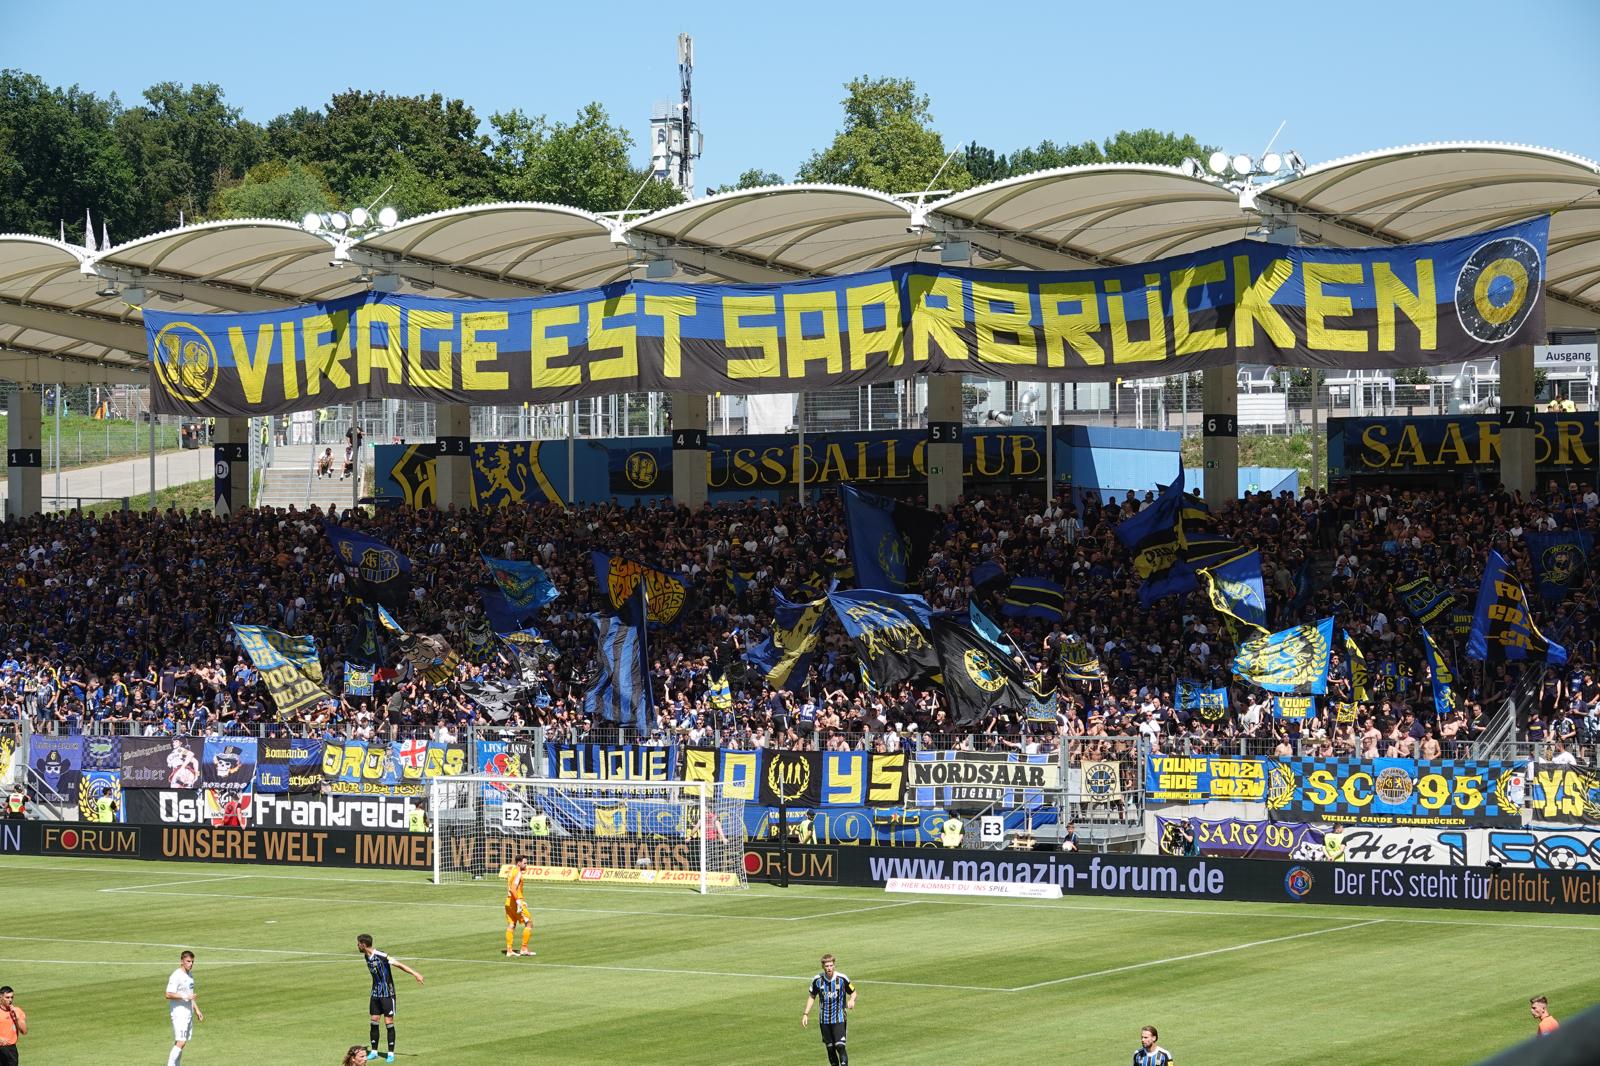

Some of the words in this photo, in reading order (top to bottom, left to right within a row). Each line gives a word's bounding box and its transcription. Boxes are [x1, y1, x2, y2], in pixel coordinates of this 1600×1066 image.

[228, 303, 509, 403] VIRAGE
[531, 293, 697, 388] EST
[722, 254, 1438, 379] SAARBRÜCKEN
[1545, 350, 1591, 363] Ausgang
[1506, 411, 1515, 424] 7
[1208, 419, 1216, 432] 6
[932, 427, 940, 439] 5
[439, 440, 447, 452] 3
[677, 436, 685, 446] 4
[11, 452, 17, 463] 1
[236, 446, 242, 458] 2
[1278, 697, 1312, 708] YOUNG
[802, 704, 815, 717] 12
[1282, 707, 1306, 717] SIDE
[558, 750, 667, 781] CLIQUE
[1151, 757, 1207, 773] YOUNG
[914, 762, 1046, 787] NORDSAAR
[332, 781, 360, 793] NUR
[363, 783, 390, 794] DER
[1159, 774, 1198, 790] SIDE
[1305, 770, 1374, 806] SC
[1416, 773, 1484, 810] 95
[1539, 769, 1584, 817] YS
[159, 791, 205, 823] Ost
[504, 808, 520, 821] E2
[1321, 814, 1357, 823] VIEILLE
[1360, 815, 1393, 824] GARDE
[1396, 816, 1466, 825] SAARBRÜCKEN
[771, 825, 802, 836] BYS
[983, 822, 1001, 836] E3
[1198, 822, 1259, 845] SARG
[1265, 825, 1294, 849] 99
[4, 824, 21, 851] N
[45, 828, 136, 852] FORUM
[162, 828, 257, 859] UNSERE
[263, 831, 328, 863] WELT
[1342, 831, 1435, 864] Heja
[603, 870, 614, 878] IST
[673, 873, 700, 882] LOTTO
[869, 856, 1224, 894] www.magazin-forum.de
[901, 881, 919, 889] HIER
[920, 882, 955, 890] KOMMST
[1334, 867, 1364, 895] Der
[1371, 868, 1404, 897] FCS
[1409, 872, 1458, 899] steht
[1463, 872, 1490, 900] für
